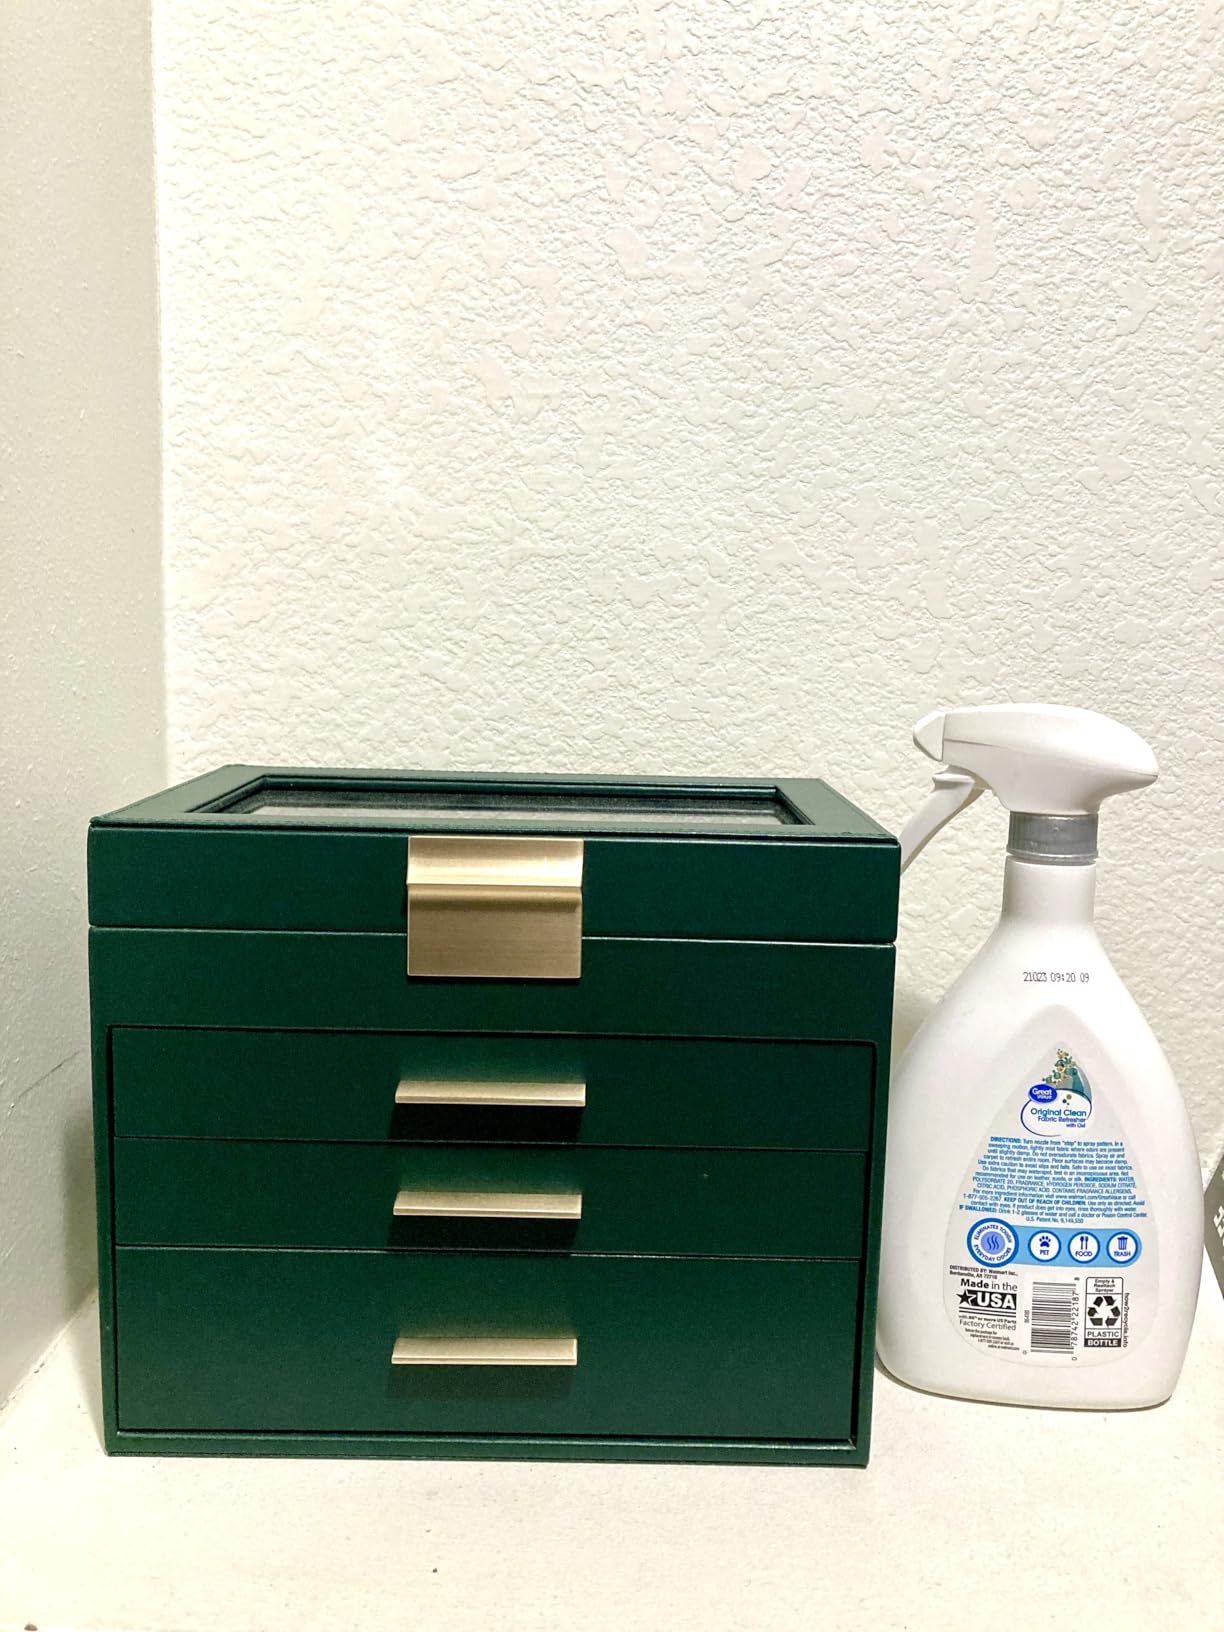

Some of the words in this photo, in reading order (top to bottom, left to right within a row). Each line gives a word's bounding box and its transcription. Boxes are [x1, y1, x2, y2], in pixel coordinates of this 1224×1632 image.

[1023, 972, 1047, 982] 21023
[1050, 972, 1075, 982] 09:20
[1080, 972, 1089, 983] 09
[1031, 1108, 1061, 1117] Original
[974, 1225, 998, 1240] ELIMINATES
[974, 1245, 995, 1261] EVERYDAY
[961, 1278, 989, 1288] Made
[992, 1282, 1000, 1290] in
[1003, 1282, 1017, 1291] the
[977, 1292, 1015, 1308] USA
[960, 1320, 984, 1328] Factory
